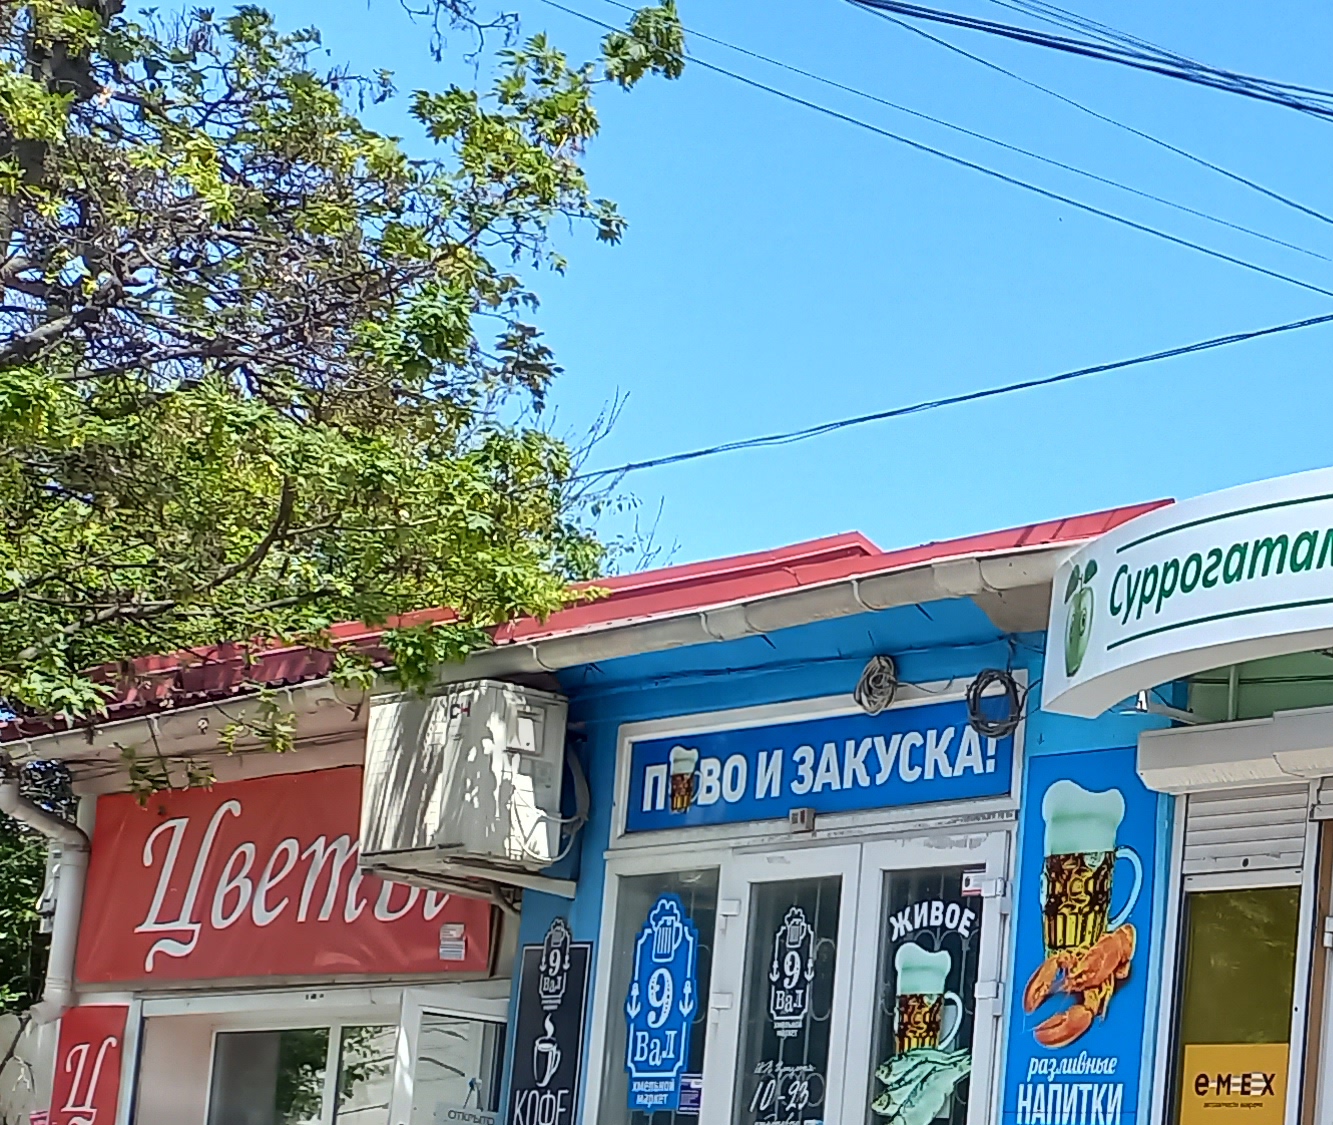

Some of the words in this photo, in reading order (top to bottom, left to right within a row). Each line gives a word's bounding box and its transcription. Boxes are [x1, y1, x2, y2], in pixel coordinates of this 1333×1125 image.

[642, 746, 748, 812] ПВО
[754, 748, 784, 800] И
[790, 723, 999, 794] ЗАКУСКА!
[889, 900, 976, 942] ЖИВОЕ
[783, 950, 801, 989] 9
[647, 967, 674, 1028] 9
[1027, 1050, 1118, 1082] разливные
[1016, 1083, 1124, 1125] НАПИТКИ
